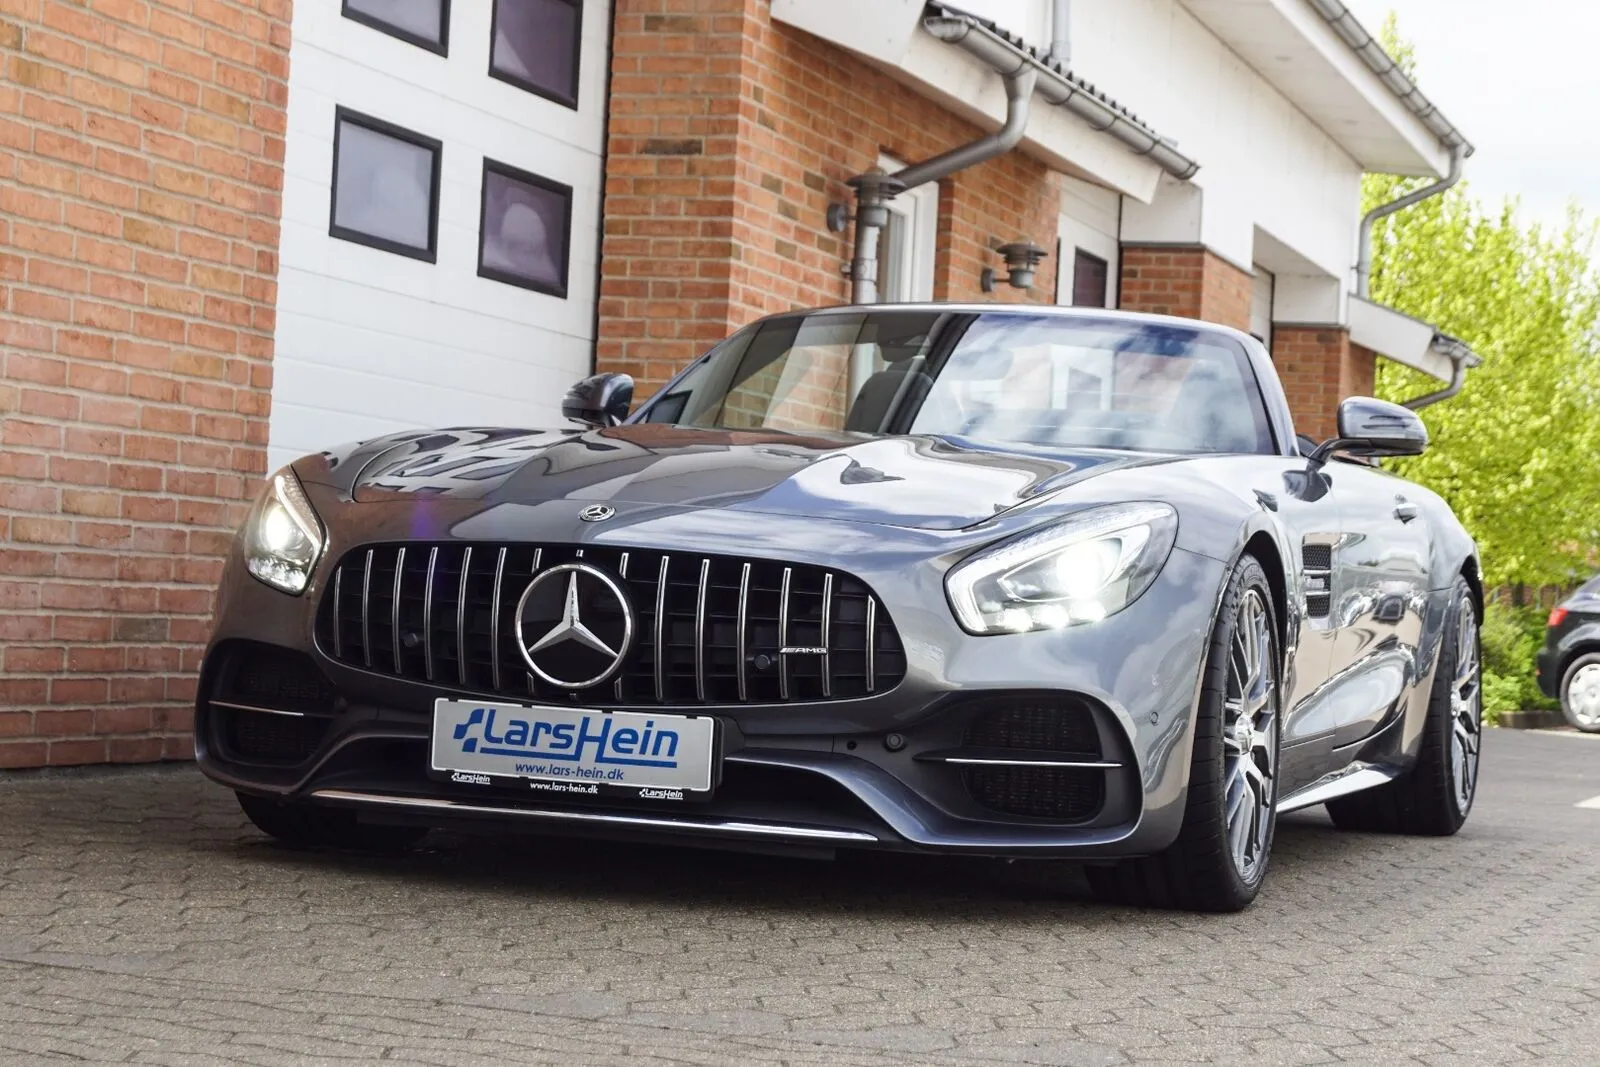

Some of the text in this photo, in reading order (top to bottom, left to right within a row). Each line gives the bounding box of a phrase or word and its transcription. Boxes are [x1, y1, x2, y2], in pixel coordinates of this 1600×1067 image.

[484, 708, 679, 765] LarsHein
[457, 773, 491, 784] LarsHein
[515, 763, 625, 781] www.lars-hein.dk
[530, 781, 598, 795] www.lars-hein.dk
[645, 788, 683, 799] LarsHein
